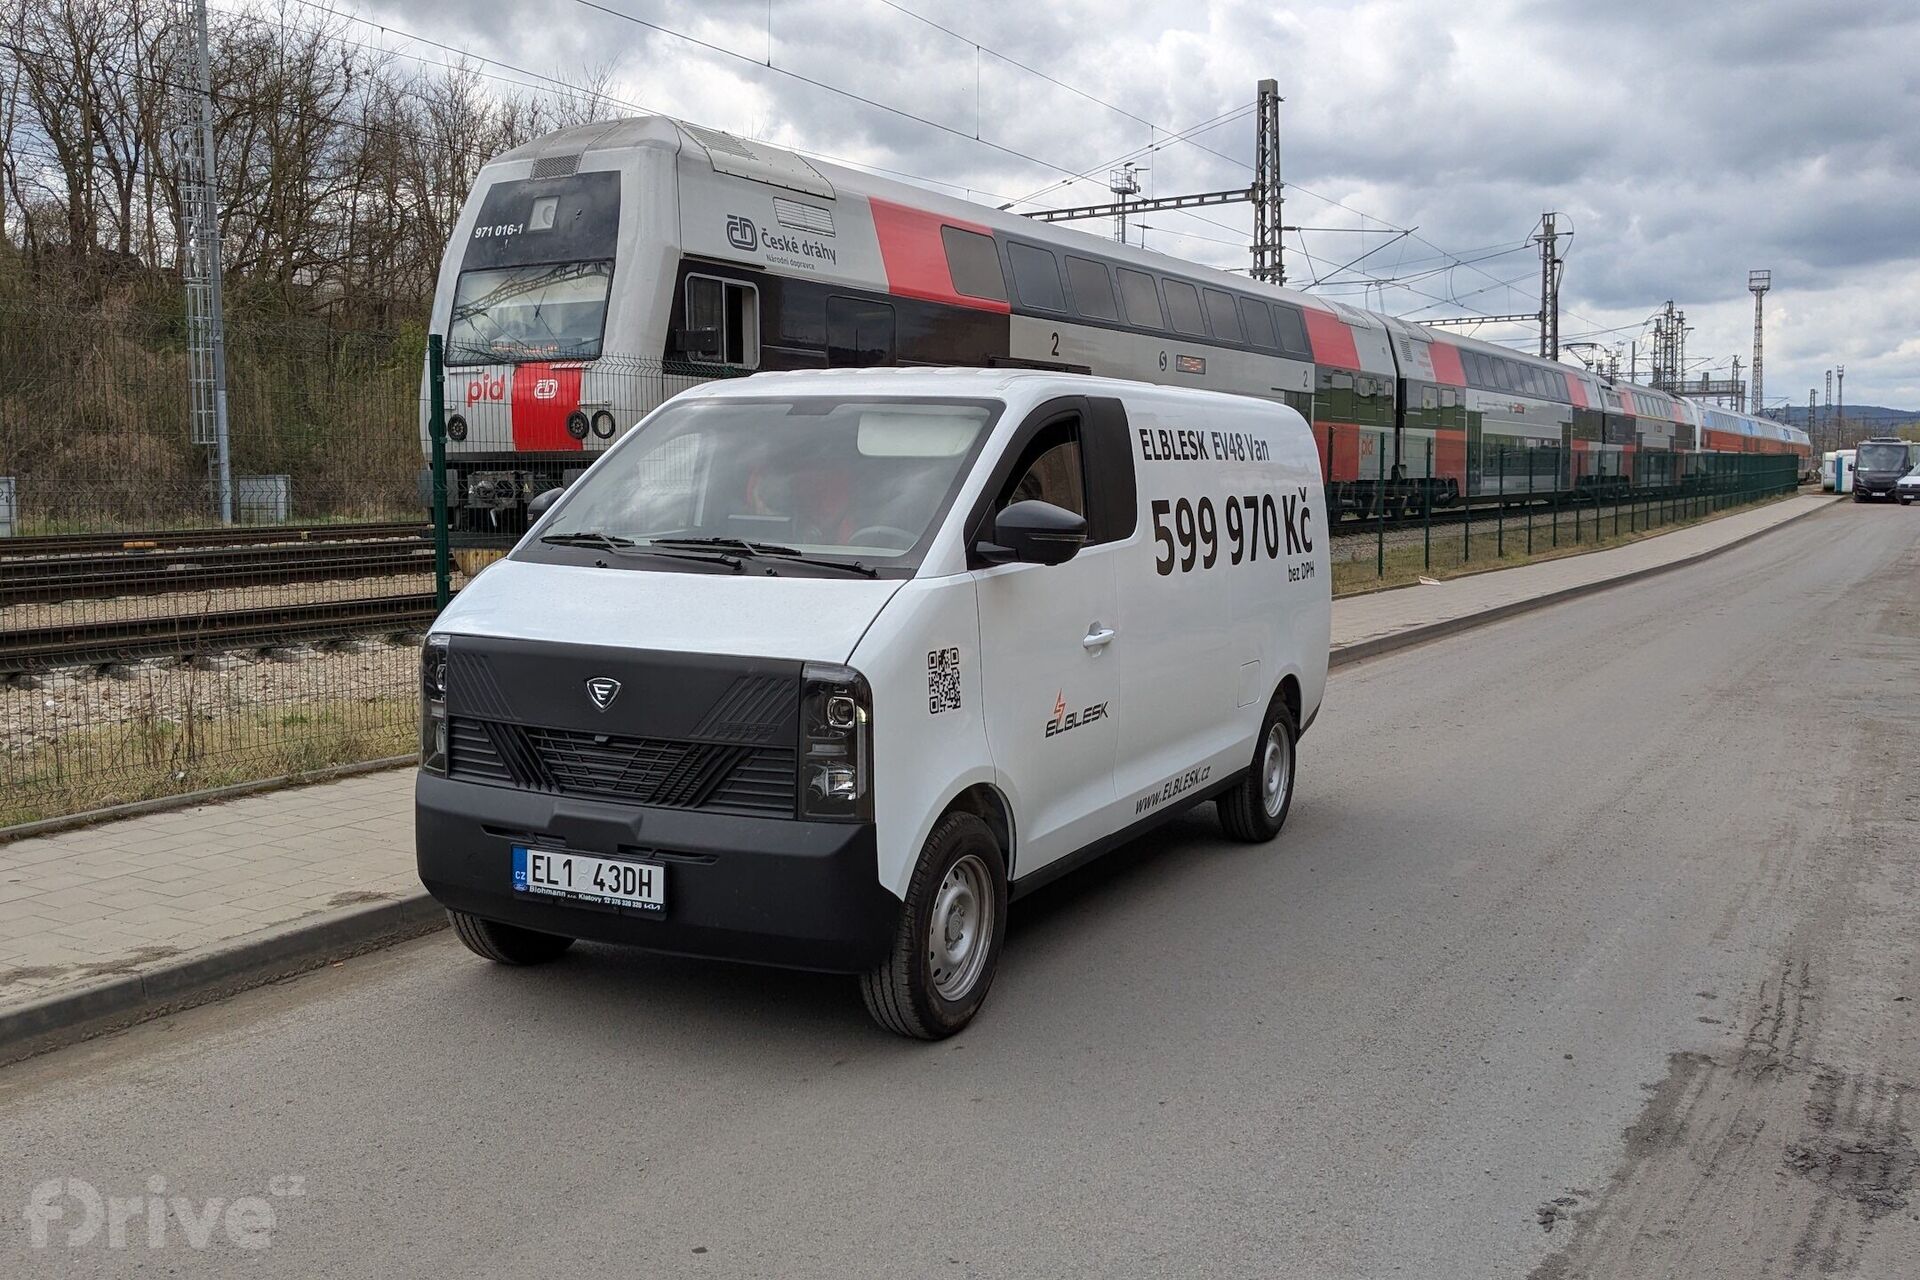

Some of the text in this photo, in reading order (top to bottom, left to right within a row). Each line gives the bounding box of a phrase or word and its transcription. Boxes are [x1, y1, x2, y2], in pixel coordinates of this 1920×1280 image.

[475, 223, 524, 239] 971 016-1
[761, 226, 837, 266] České dráhy
[766, 254, 815, 270] Národní dopravce
[1051, 332, 1060, 356] 2
[467, 374, 505, 407] pid
[1303, 369, 1309, 388] 2
[1138, 428, 1270, 463] ELBLESK EV48 Van
[1151, 486, 1313, 577] 599 970 Kč
[1287, 560, 1315, 583] bez DPH
[1045, 701, 1110, 739] ELBLESK
[515, 870, 526, 880] CZ
[532, 854, 652, 898] EL1 43DH
[578, 893, 602, 904] Klatovy
